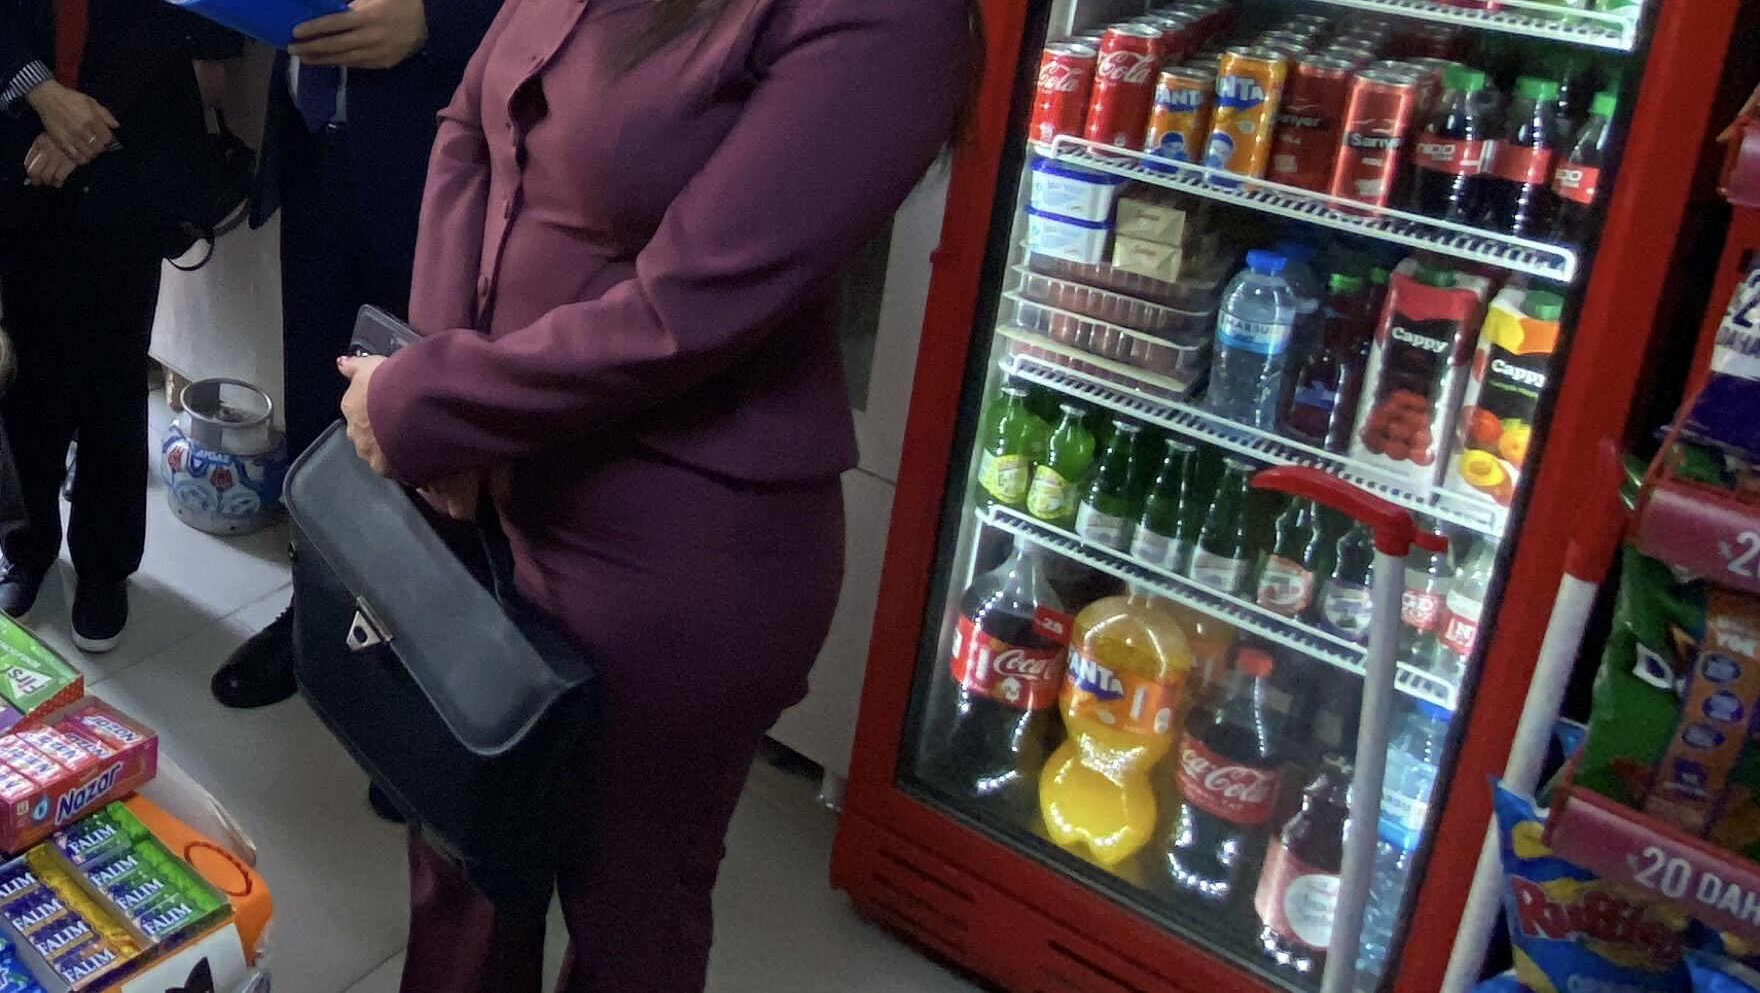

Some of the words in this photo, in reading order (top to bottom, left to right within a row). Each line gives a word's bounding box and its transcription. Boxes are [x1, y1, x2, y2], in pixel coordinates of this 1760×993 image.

[1156, 84, 1204, 106] ANT
[1217, 75, 1265, 101] NTA
[1392, 326, 1448, 354] Cappy
[1, 663, 48, 699] First
[83, 715, 141, 744] Nazar
[54, 763, 123, 826] Nazar
[67, 824, 116, 856] FALIM
[90, 855, 139, 887] FALIM
[115, 878, 165, 911] FALIM
[12, 898, 64, 932] FALIM
[141, 902, 191, 938] FALIM
[37, 919, 90, 958] FALIM
[62, 948, 117, 984] FALIM
